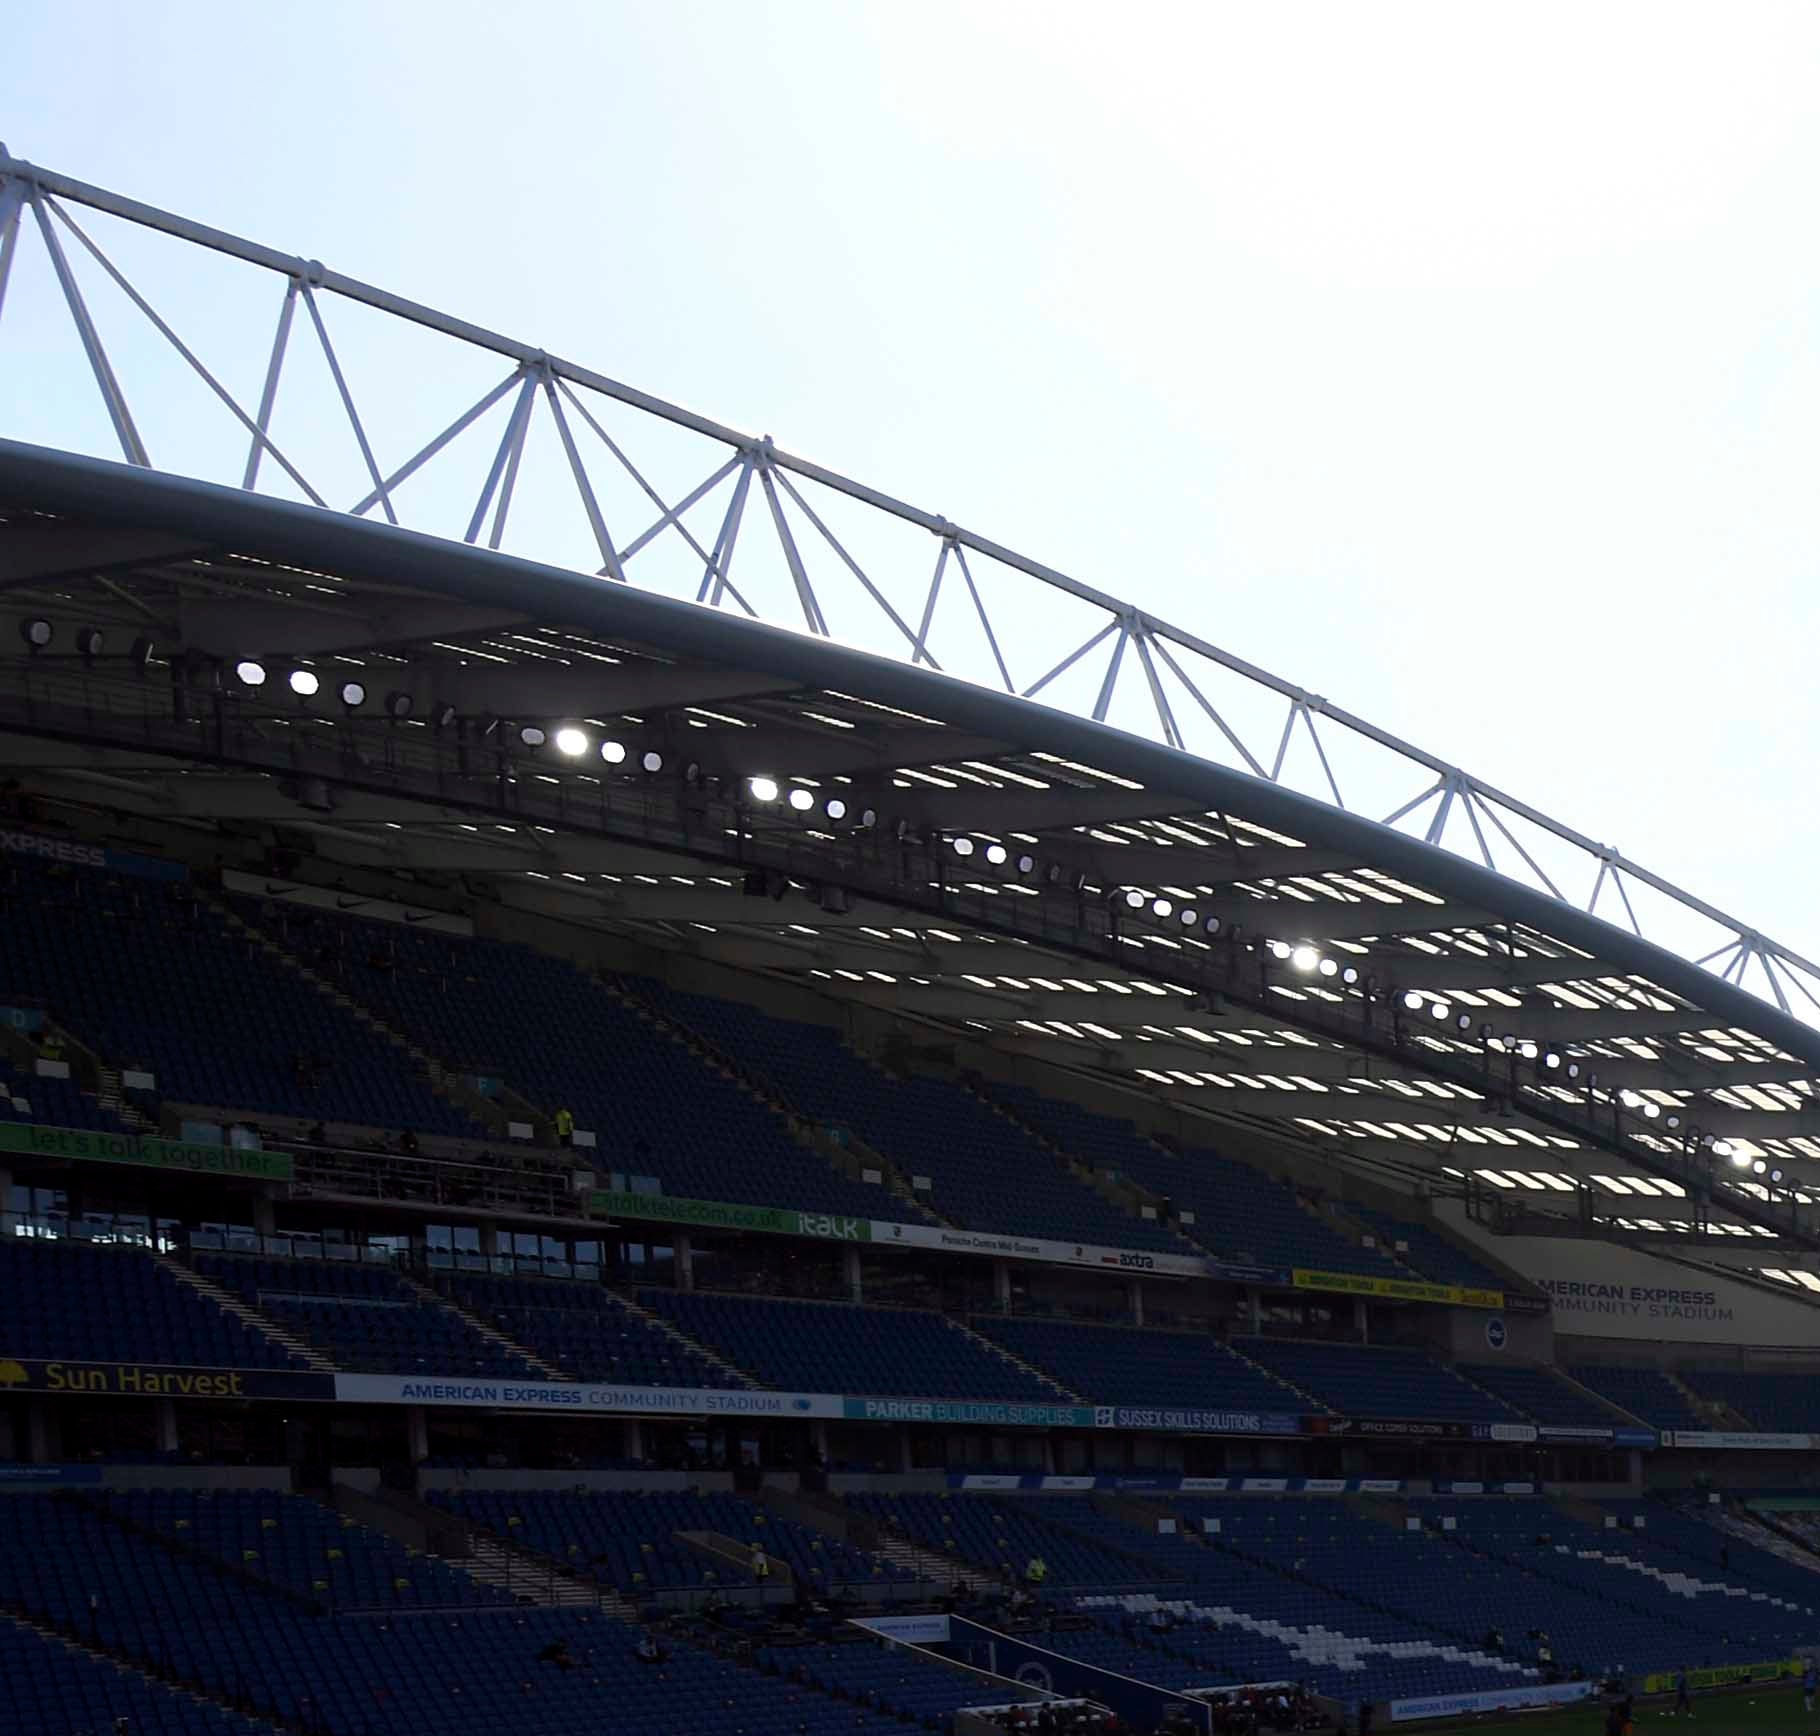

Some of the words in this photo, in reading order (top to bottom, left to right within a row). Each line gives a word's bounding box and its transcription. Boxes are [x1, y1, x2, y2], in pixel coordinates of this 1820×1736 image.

[799, 1212, 861, 1239] italk
[1538, 1279, 1624, 1298] MERICAN
[1631, 1287, 1716, 1305] EXPRESS
[1552, 1299, 1641, 1317] MMUNITY
[1648, 1303, 1734, 1321] STADIUM
[45, 1361, 109, 1391] Sun
[116, 1365, 244, 1396] Harvest
[401, 1383, 497, 1402] AMERICAN
[503, 1387, 582, 1404] EXPRESS
[588, 1390, 699, 1408] COMMUNITY
[706, 1395, 782, 1411] STADIUM
[865, 1401, 933, 1419] PARKER
[935, 1403, 1006, 1422] BUILDING
[1007, 1406, 1075, 1426] SUPPLIES
[1118, 1408, 1165, 1427] SUSSEX
[1166, 1409, 1202, 1428] SKILLS
[1203, 1411, 1262, 1431] SOLUTIONS
